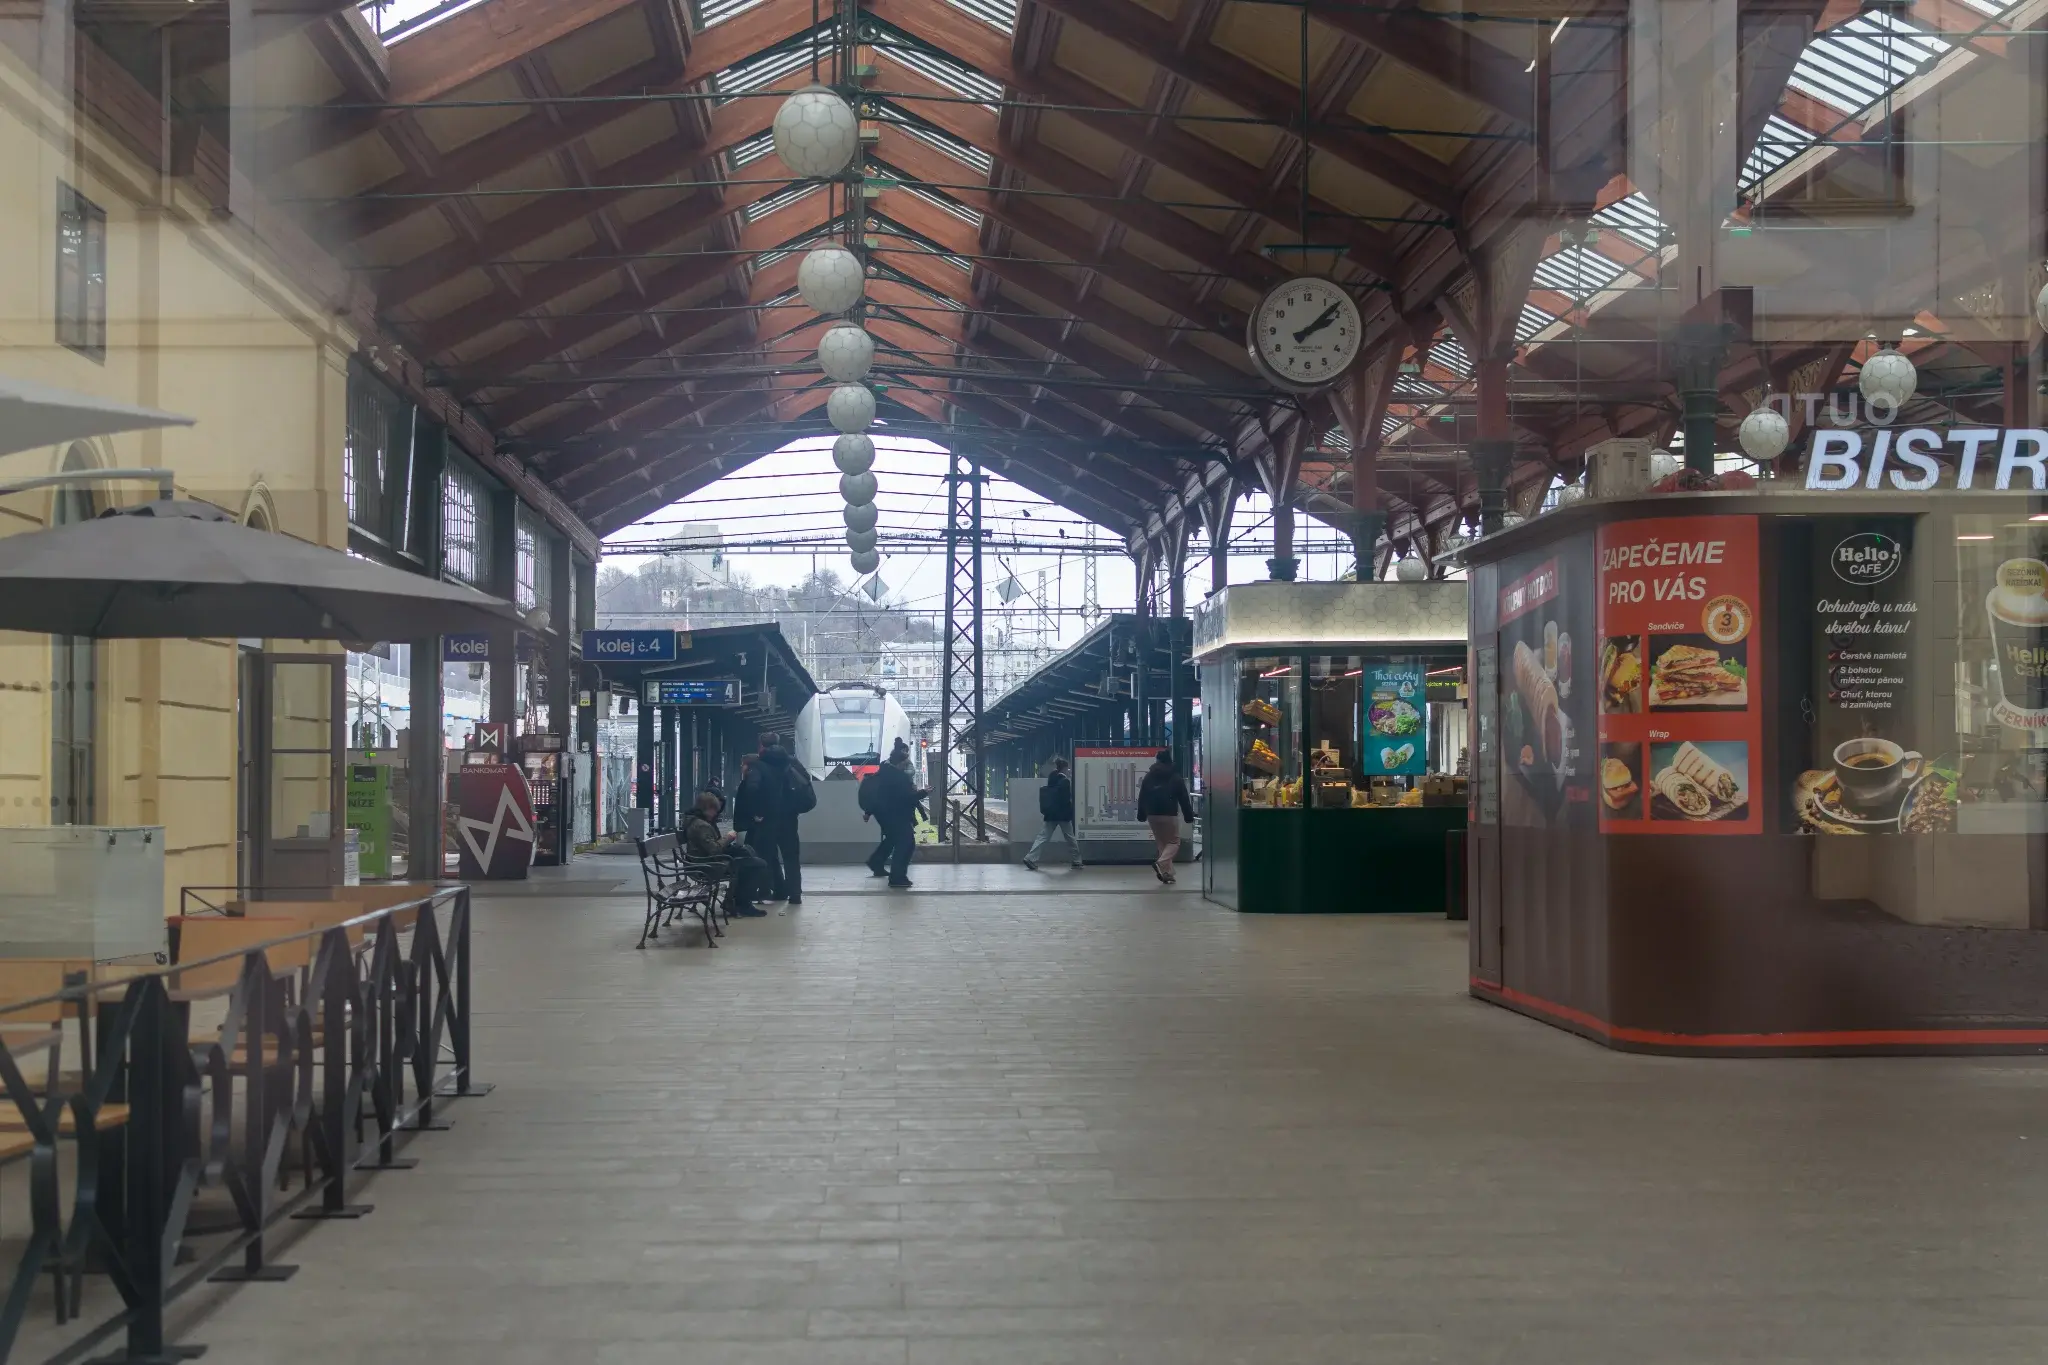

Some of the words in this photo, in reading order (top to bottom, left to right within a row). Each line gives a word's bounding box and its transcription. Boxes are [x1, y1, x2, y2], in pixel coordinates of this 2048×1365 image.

[1304, 293, 1312, 302] 12
[1287, 298, 1294, 307] 11
[1323, 298, 1327, 307] 1
[1276, 310, 1285, 319] 10
[1334, 310, 1340, 319] 2
[1270, 327, 1276, 335] 9
[1340, 327, 1346, 336] 3
[1275, 344, 1281, 352] 8
[1334, 344, 1340, 353] 4
[1288, 357, 1295, 366] 7
[1304, 362, 1311, 370] 6
[1321, 357, 1328, 366] 5
[1805, 428, 2048, 490] BISTR
[1602, 537, 1726, 571] ZAPEČEME
[1849, 561, 1882, 575] CAFÉ
[1540, 569, 1553, 596] DOG
[1609, 579, 1646, 604] PRO
[1653, 571, 1707, 601] VÁS
[1816, 599, 1880, 620] Ochutnejte
[1883, 604, 1892, 613] u
[1894, 601, 1918, 613] nás
[1721, 613, 1732, 627] 3
[1648, 621, 1685, 631] Sendviče
[1825, 620, 1870, 634] skvělou
[1873, 620, 1911, 634] kávu!
[450, 639, 489, 657] kolej
[596, 638, 635, 655] kolej
[1840, 651, 1872, 660] Čerstvě
[1874, 651, 1907, 660] namletá
[1840, 666, 1846, 674] S
[1848, 666, 1882, 674] bohatou
[1840, 676, 1876, 684] mléčnou
[1877, 676, 1904, 685] pěnou
[725, 683, 733, 699] 4
[1865, 690, 1892, 699] kterou
[1840, 701, 1848, 709] si
[1849, 701, 1892, 710] zamilujete
[1649, 729, 1670, 739] Wrap
